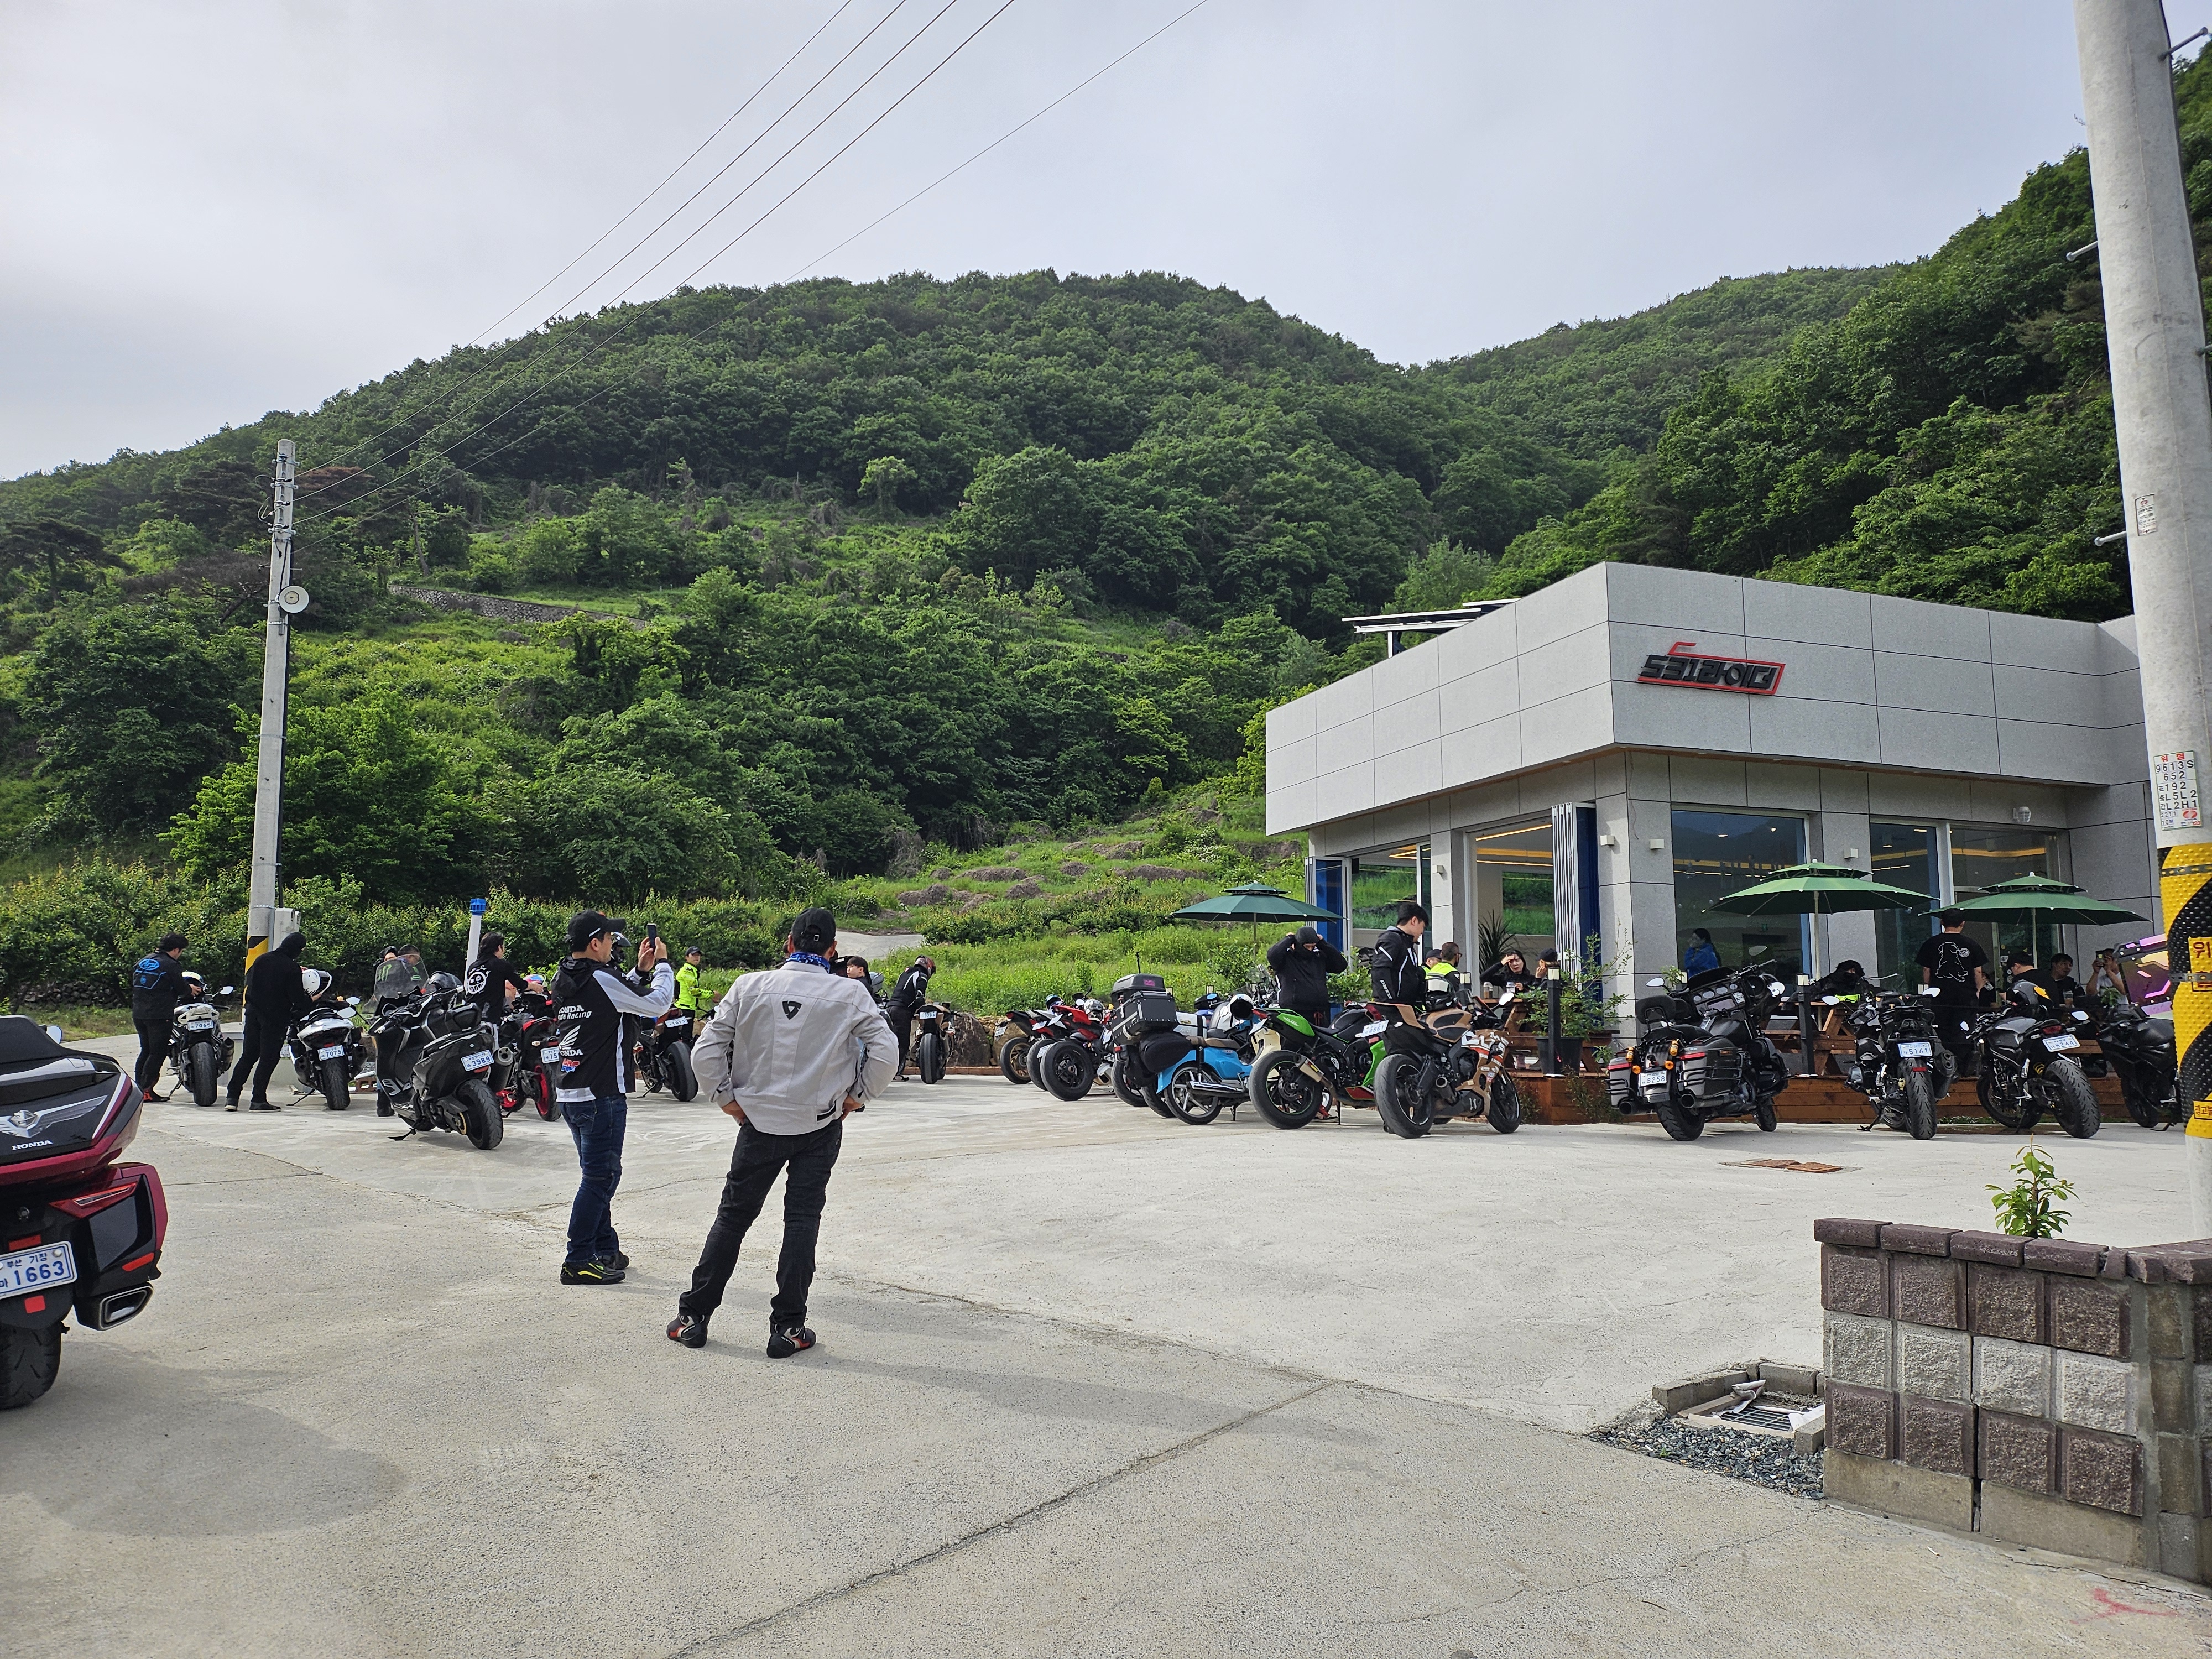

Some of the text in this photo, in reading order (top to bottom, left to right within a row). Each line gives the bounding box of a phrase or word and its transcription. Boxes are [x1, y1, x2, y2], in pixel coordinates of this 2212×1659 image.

[2156, 760, 2194, 772] 9613S
[2163, 771, 2185, 781] 652
[559, 1005, 584, 1014] ONDA
[567, 1011, 592, 1020] Racing
[472, 1056, 491, 1066] 3989
[12, 1140, 53, 1150] HONDA
[7, 1253, 47, 1268] 부산 기장
[14, 1261, 65, 1285] 1663
